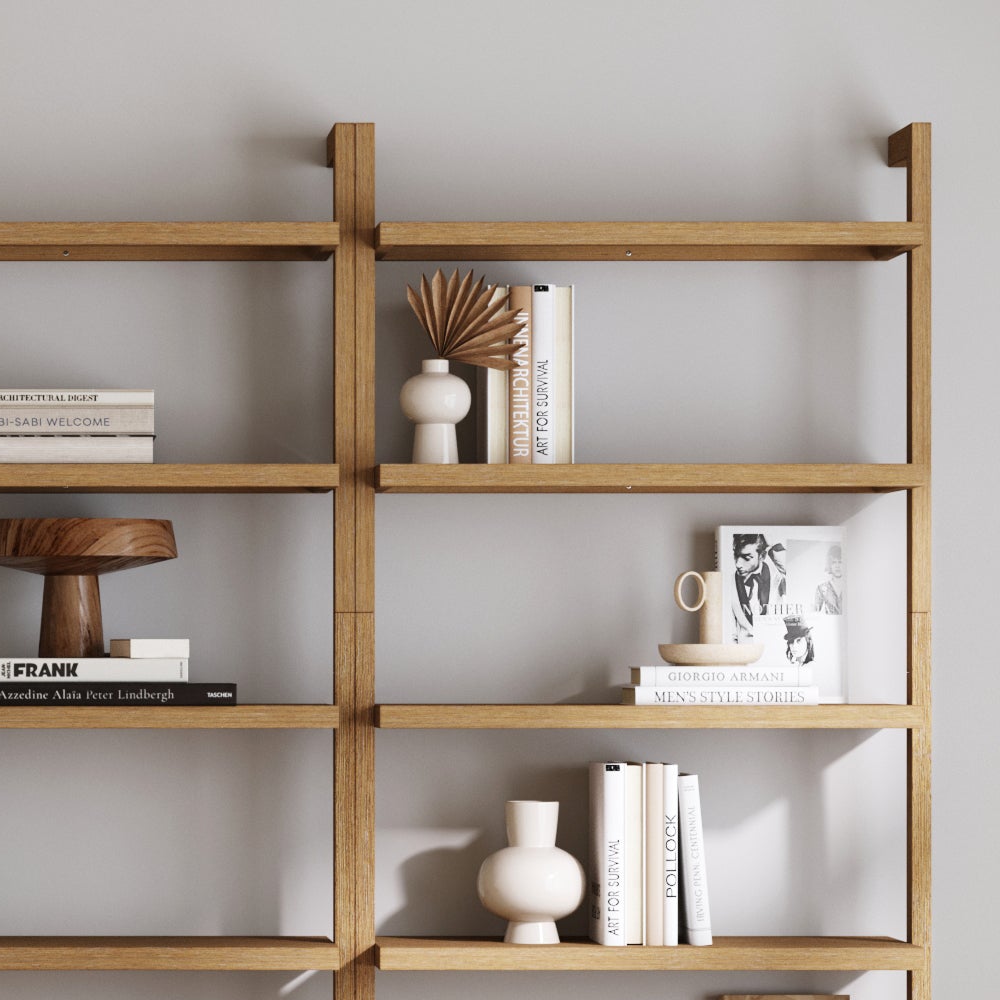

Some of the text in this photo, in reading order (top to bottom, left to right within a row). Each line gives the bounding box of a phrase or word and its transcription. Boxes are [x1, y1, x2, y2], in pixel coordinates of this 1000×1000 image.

[67, 394, 99, 402] DIGEST
[536, 359, 549, 456] ART FOR SURVIVAL
[46, 417, 110, 427] WELCOME
[13, 662, 79, 678] FRANK
[667, 671, 785, 682] GIORGIO ARMANI
[85, 689, 114, 700] Peter
[117, 689, 175, 703] Lindbergh
[654, 691, 805, 704] MEN'S STYLE STORIES
[665, 814, 677, 898] POLLOCK
[607, 839, 620, 936] ART FOR SURVIVAL
